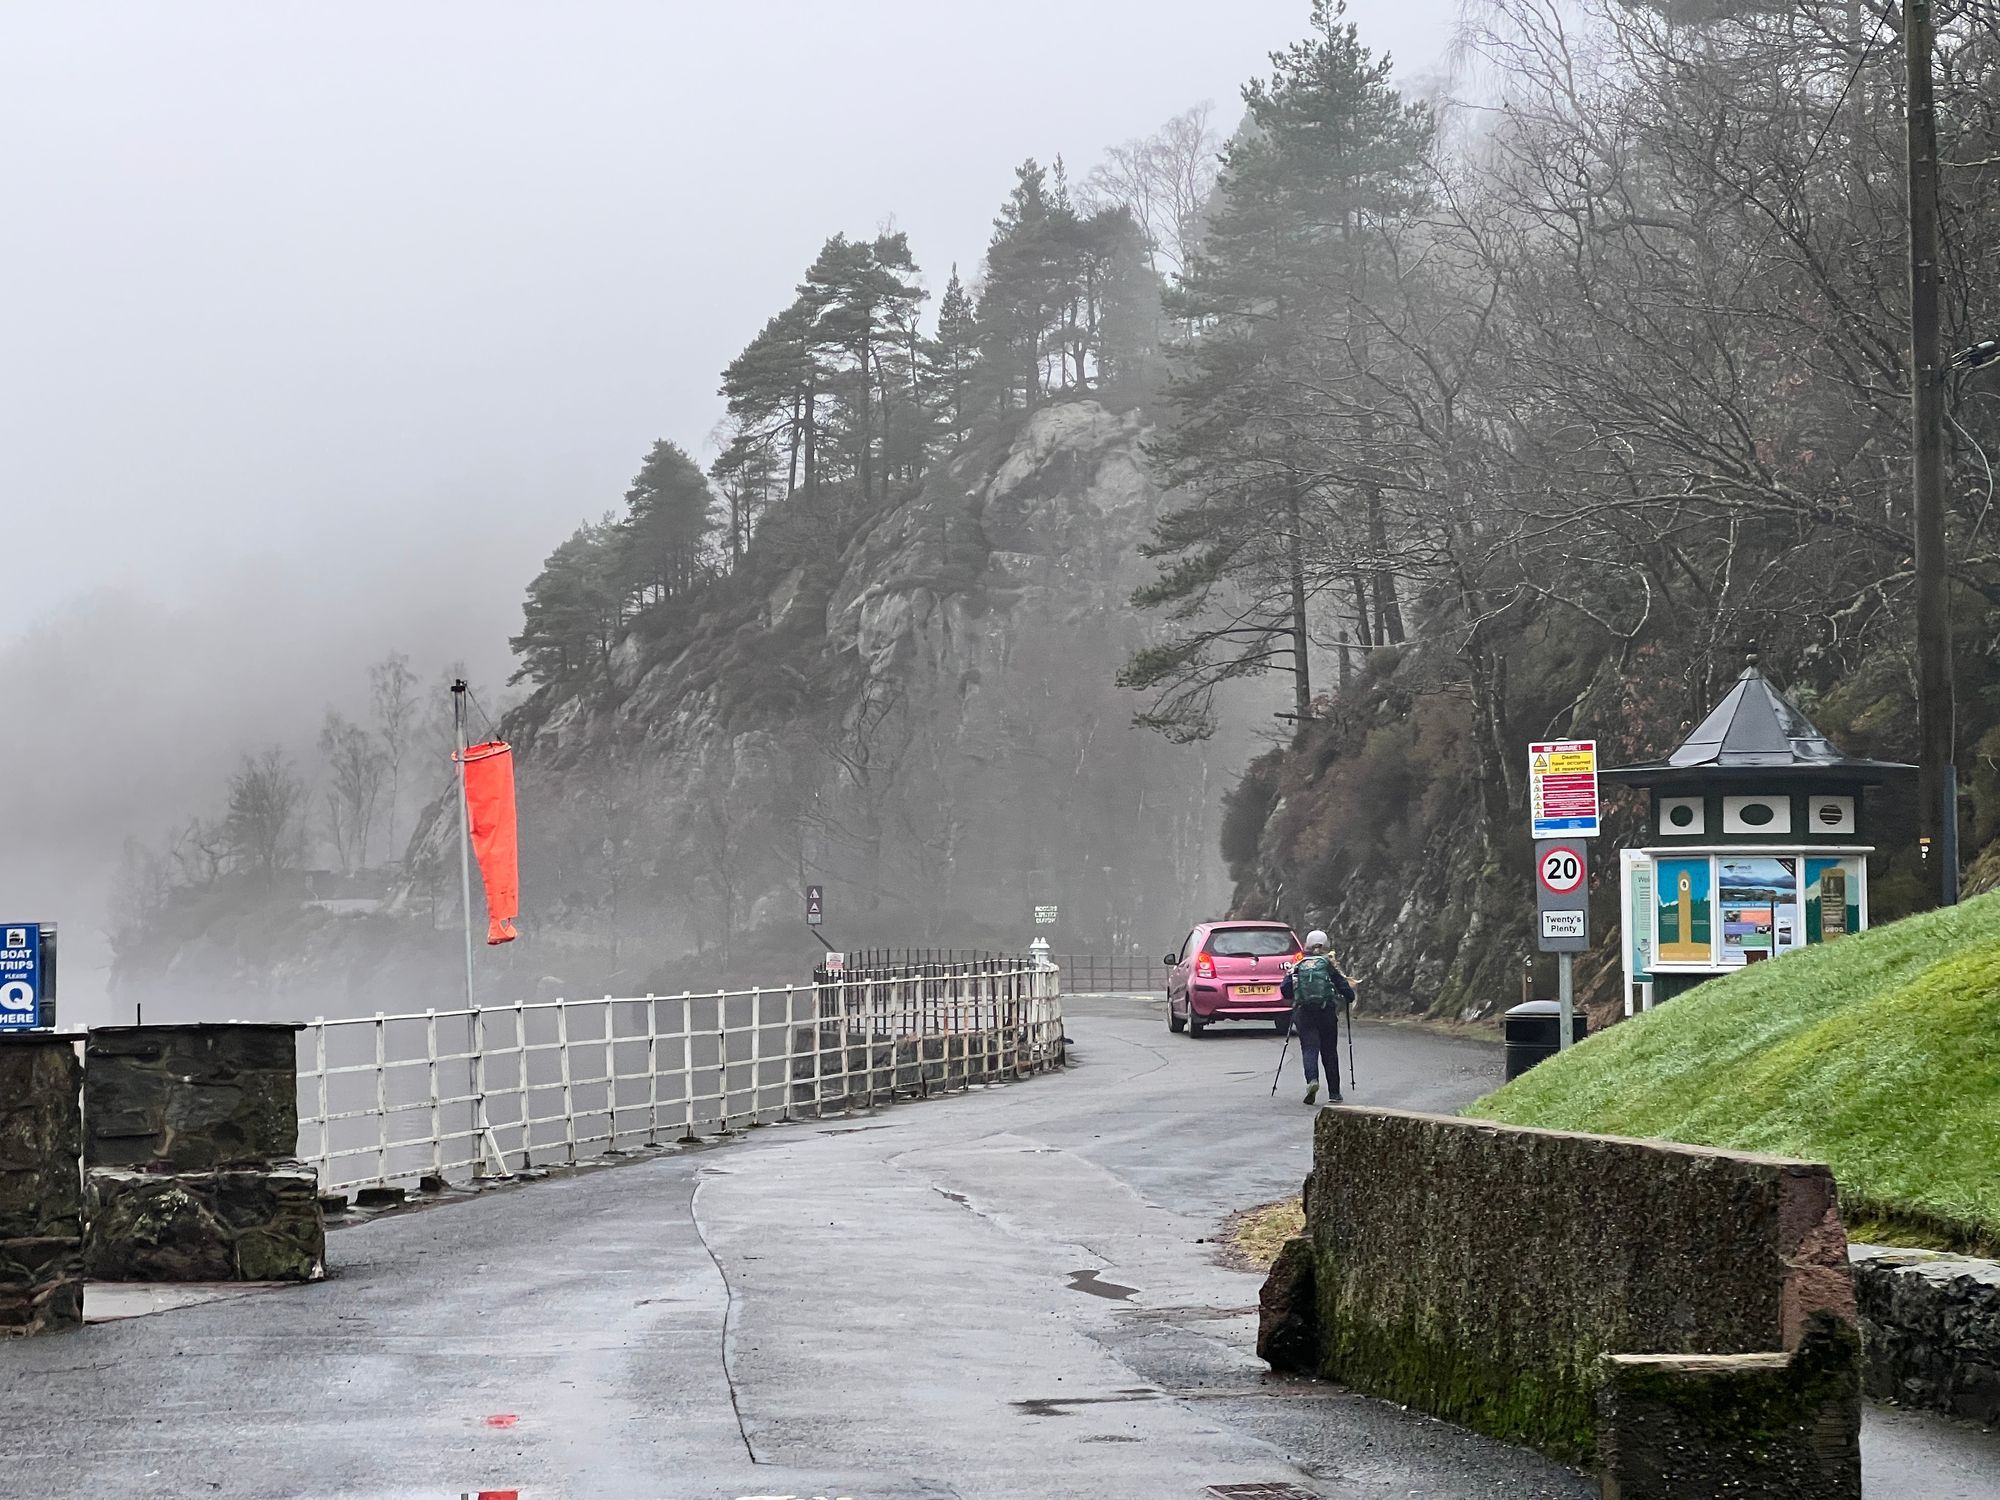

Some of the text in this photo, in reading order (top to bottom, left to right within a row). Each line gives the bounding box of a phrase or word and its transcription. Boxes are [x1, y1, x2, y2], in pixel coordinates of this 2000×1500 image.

[1548, 858, 1577, 879] 20
[1546, 916, 1581, 924] Twenty's
[1551, 925, 1576, 933] Plenty
[0, 949, 32, 959] BOAT
[0, 960, 34, 970] TRIPS
[0, 981, 34, 1011] Q
[0, 1013, 34, 1023] HERE
